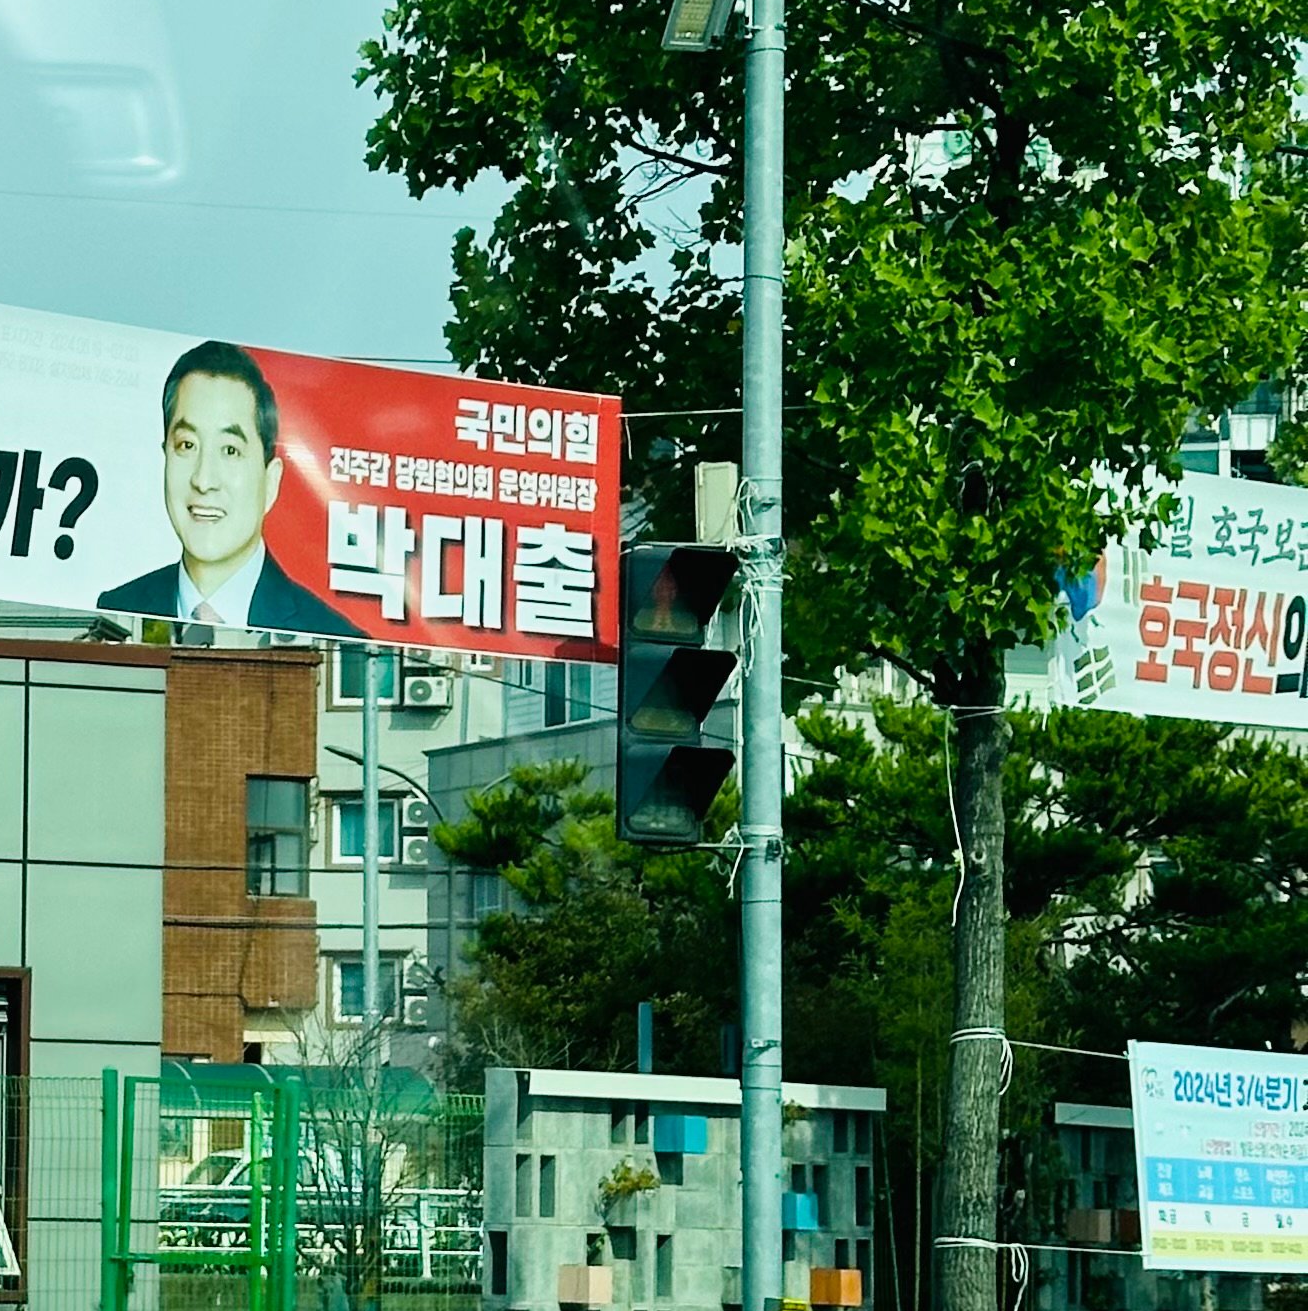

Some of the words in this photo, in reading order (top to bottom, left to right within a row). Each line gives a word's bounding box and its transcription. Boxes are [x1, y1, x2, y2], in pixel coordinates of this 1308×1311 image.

[454, 397, 599, 465] 국민의힘
[329, 446, 392, 488] 진주갑
[395, 454, 494, 501] 당원협의회
[498, 467, 598, 512] 운영위원장
[327, 499, 596, 639] 박대출
[1173, 1069, 1232, 1108] 2024년
[1236, 1074, 1299, 1113] 3/4분기
